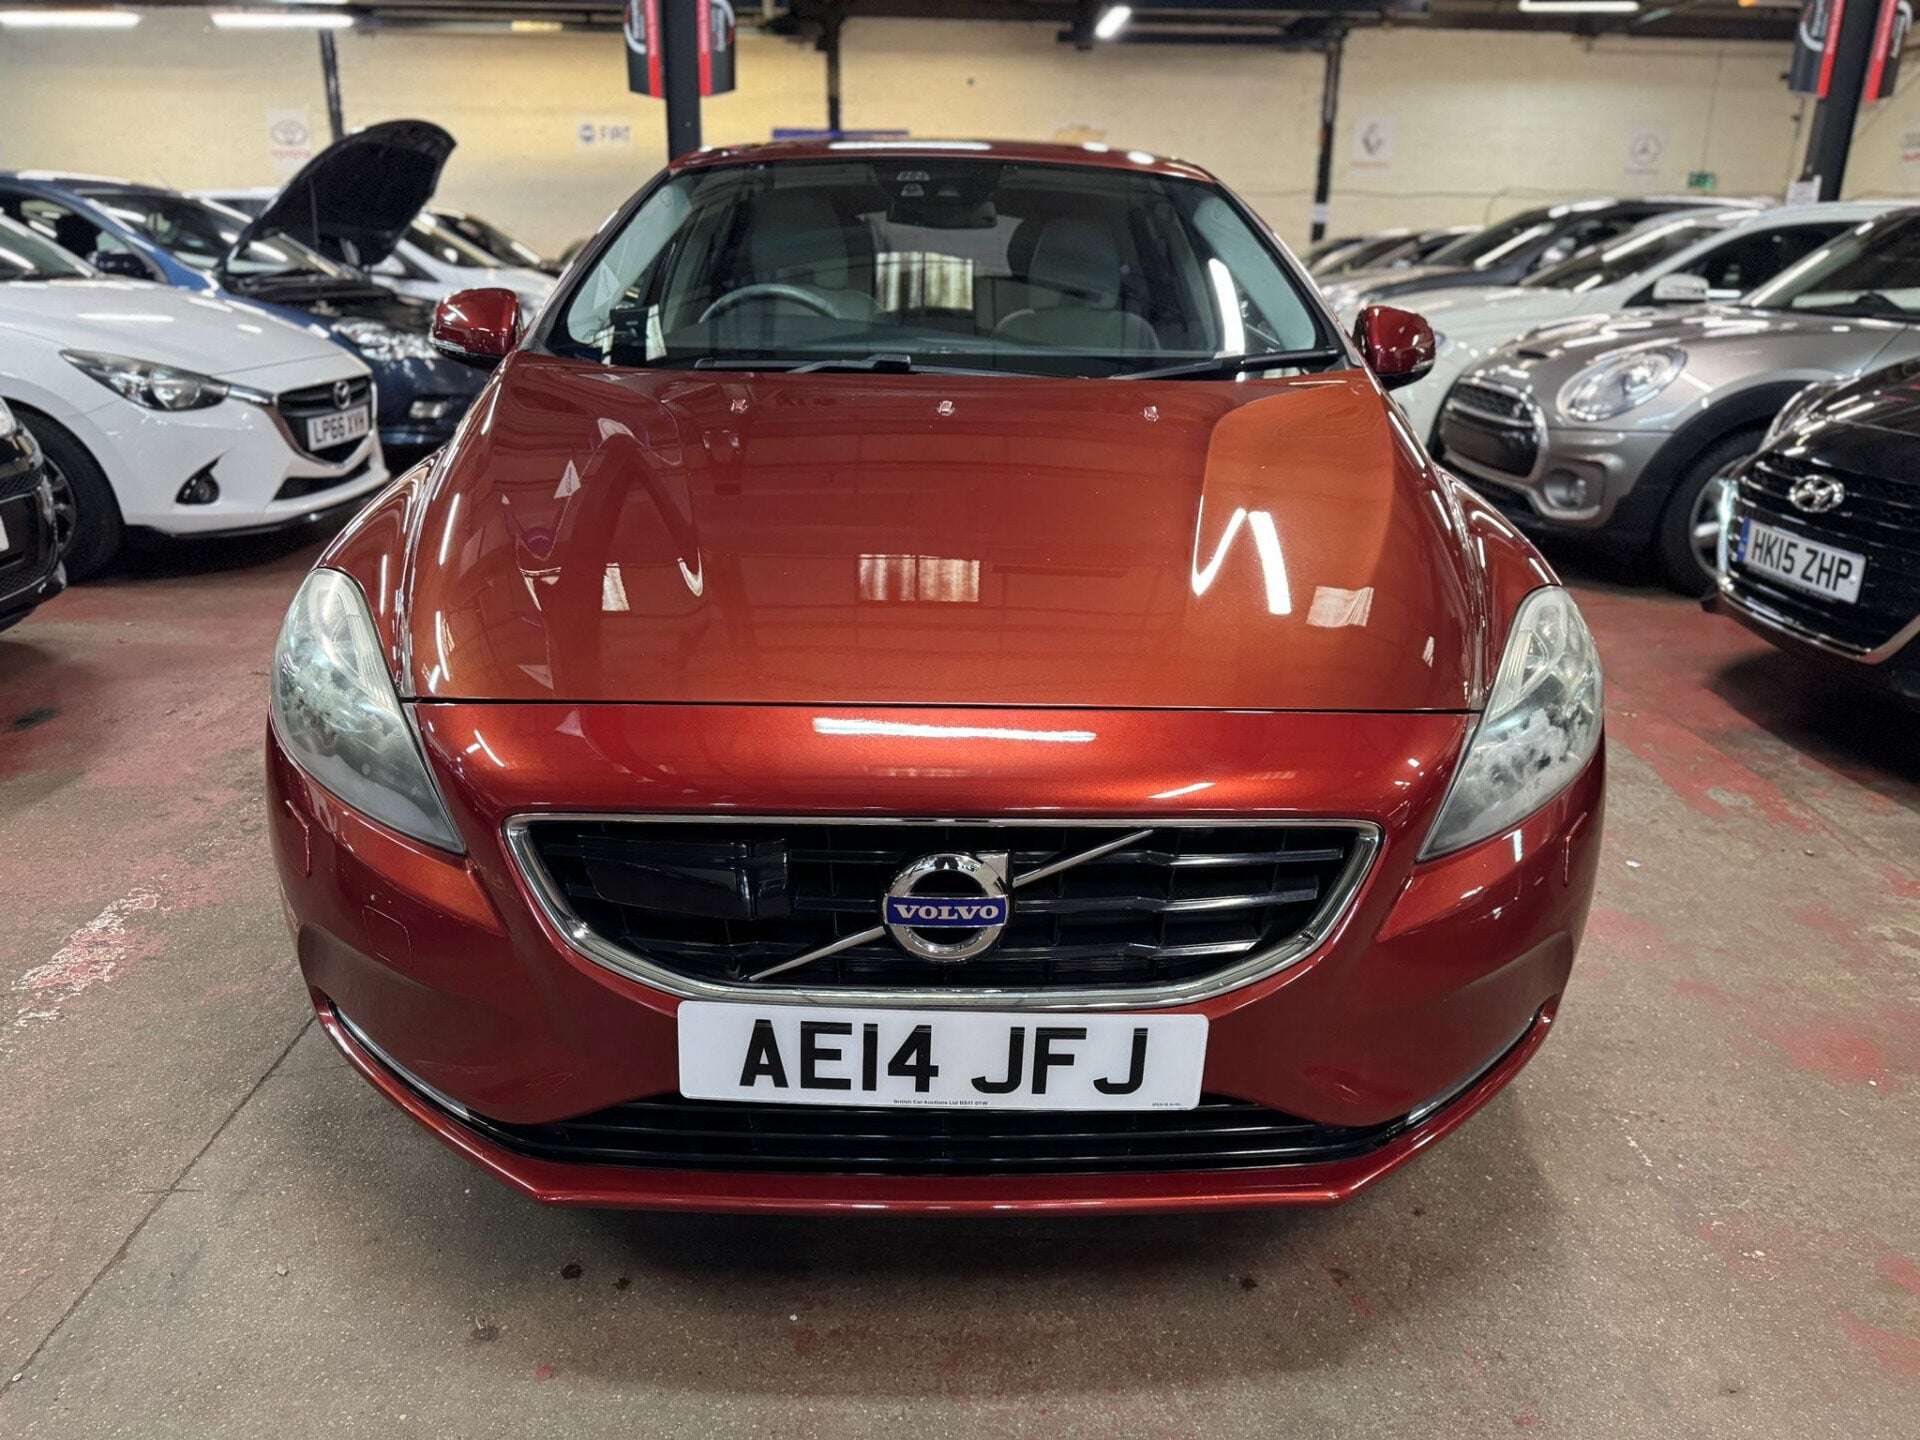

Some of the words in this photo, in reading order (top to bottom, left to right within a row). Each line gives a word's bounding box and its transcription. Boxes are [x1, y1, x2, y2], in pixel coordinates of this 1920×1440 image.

[1751, 529, 1798, 574] HK15
[1801, 547, 1853, 591] ZHP
[893, 904, 999, 920] VOLVO
[739, 1019, 938, 1093] AE14
[971, 1026, 1149, 1095] JFJ
